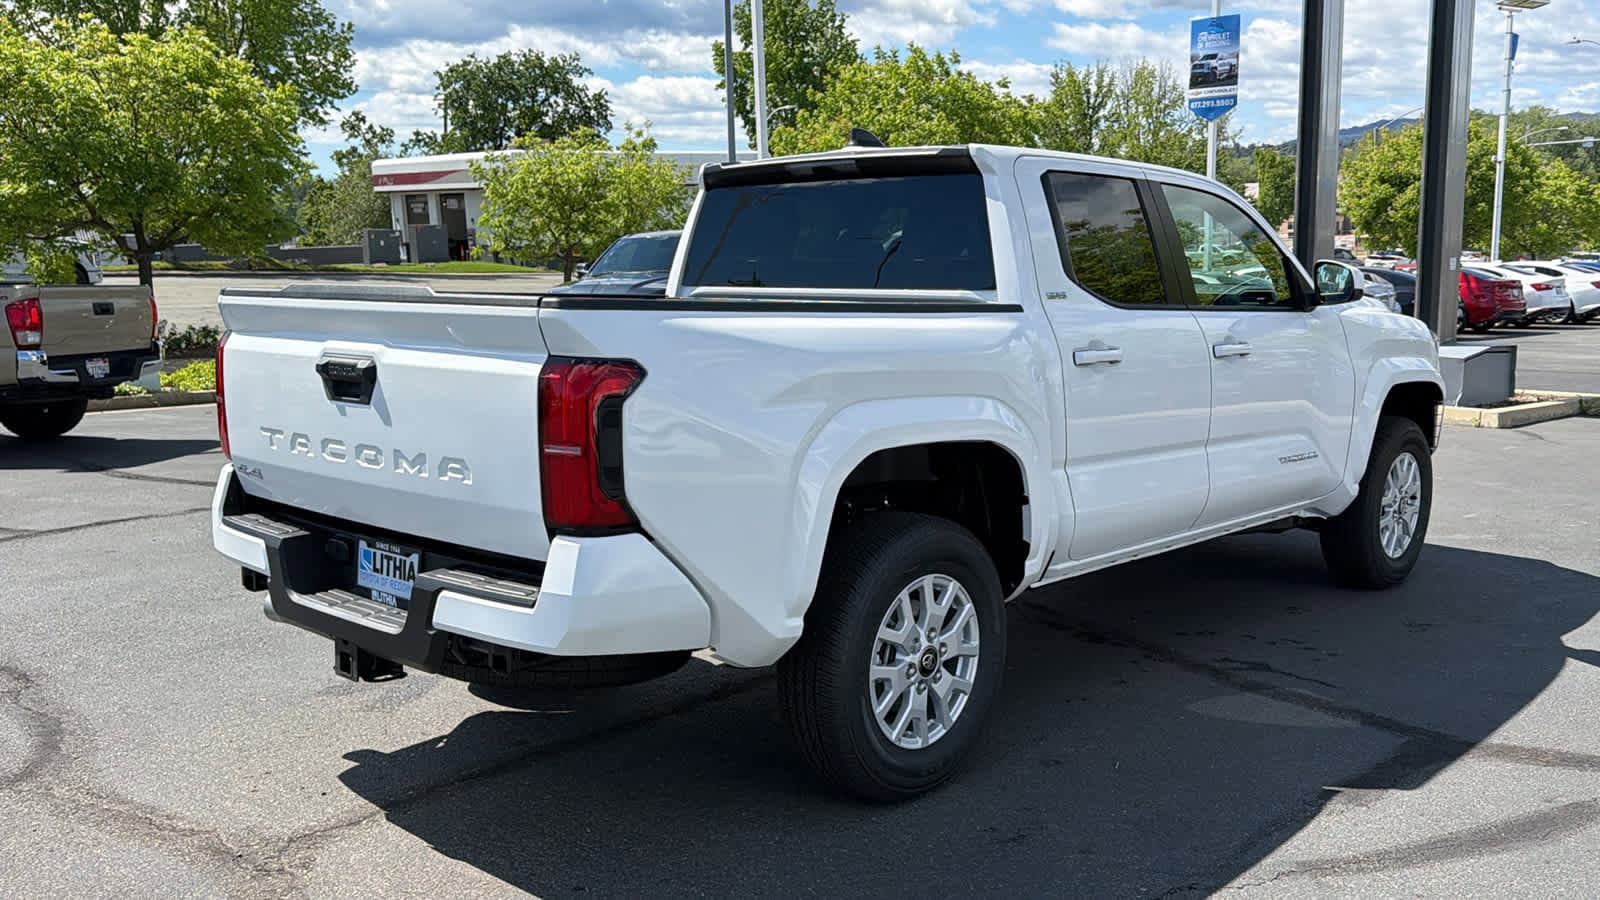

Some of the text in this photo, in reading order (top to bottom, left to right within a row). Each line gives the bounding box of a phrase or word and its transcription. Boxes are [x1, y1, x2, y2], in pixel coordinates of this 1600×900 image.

[1197, 31, 1231, 42] CHEVROLET
[260, 425, 473, 486] TACOMA
[375, 541, 389, 551] SINCE
[372, 551, 416, 583] LITHIA
[381, 576, 389, 587] OF
[378, 593, 398, 608] LITHIA
